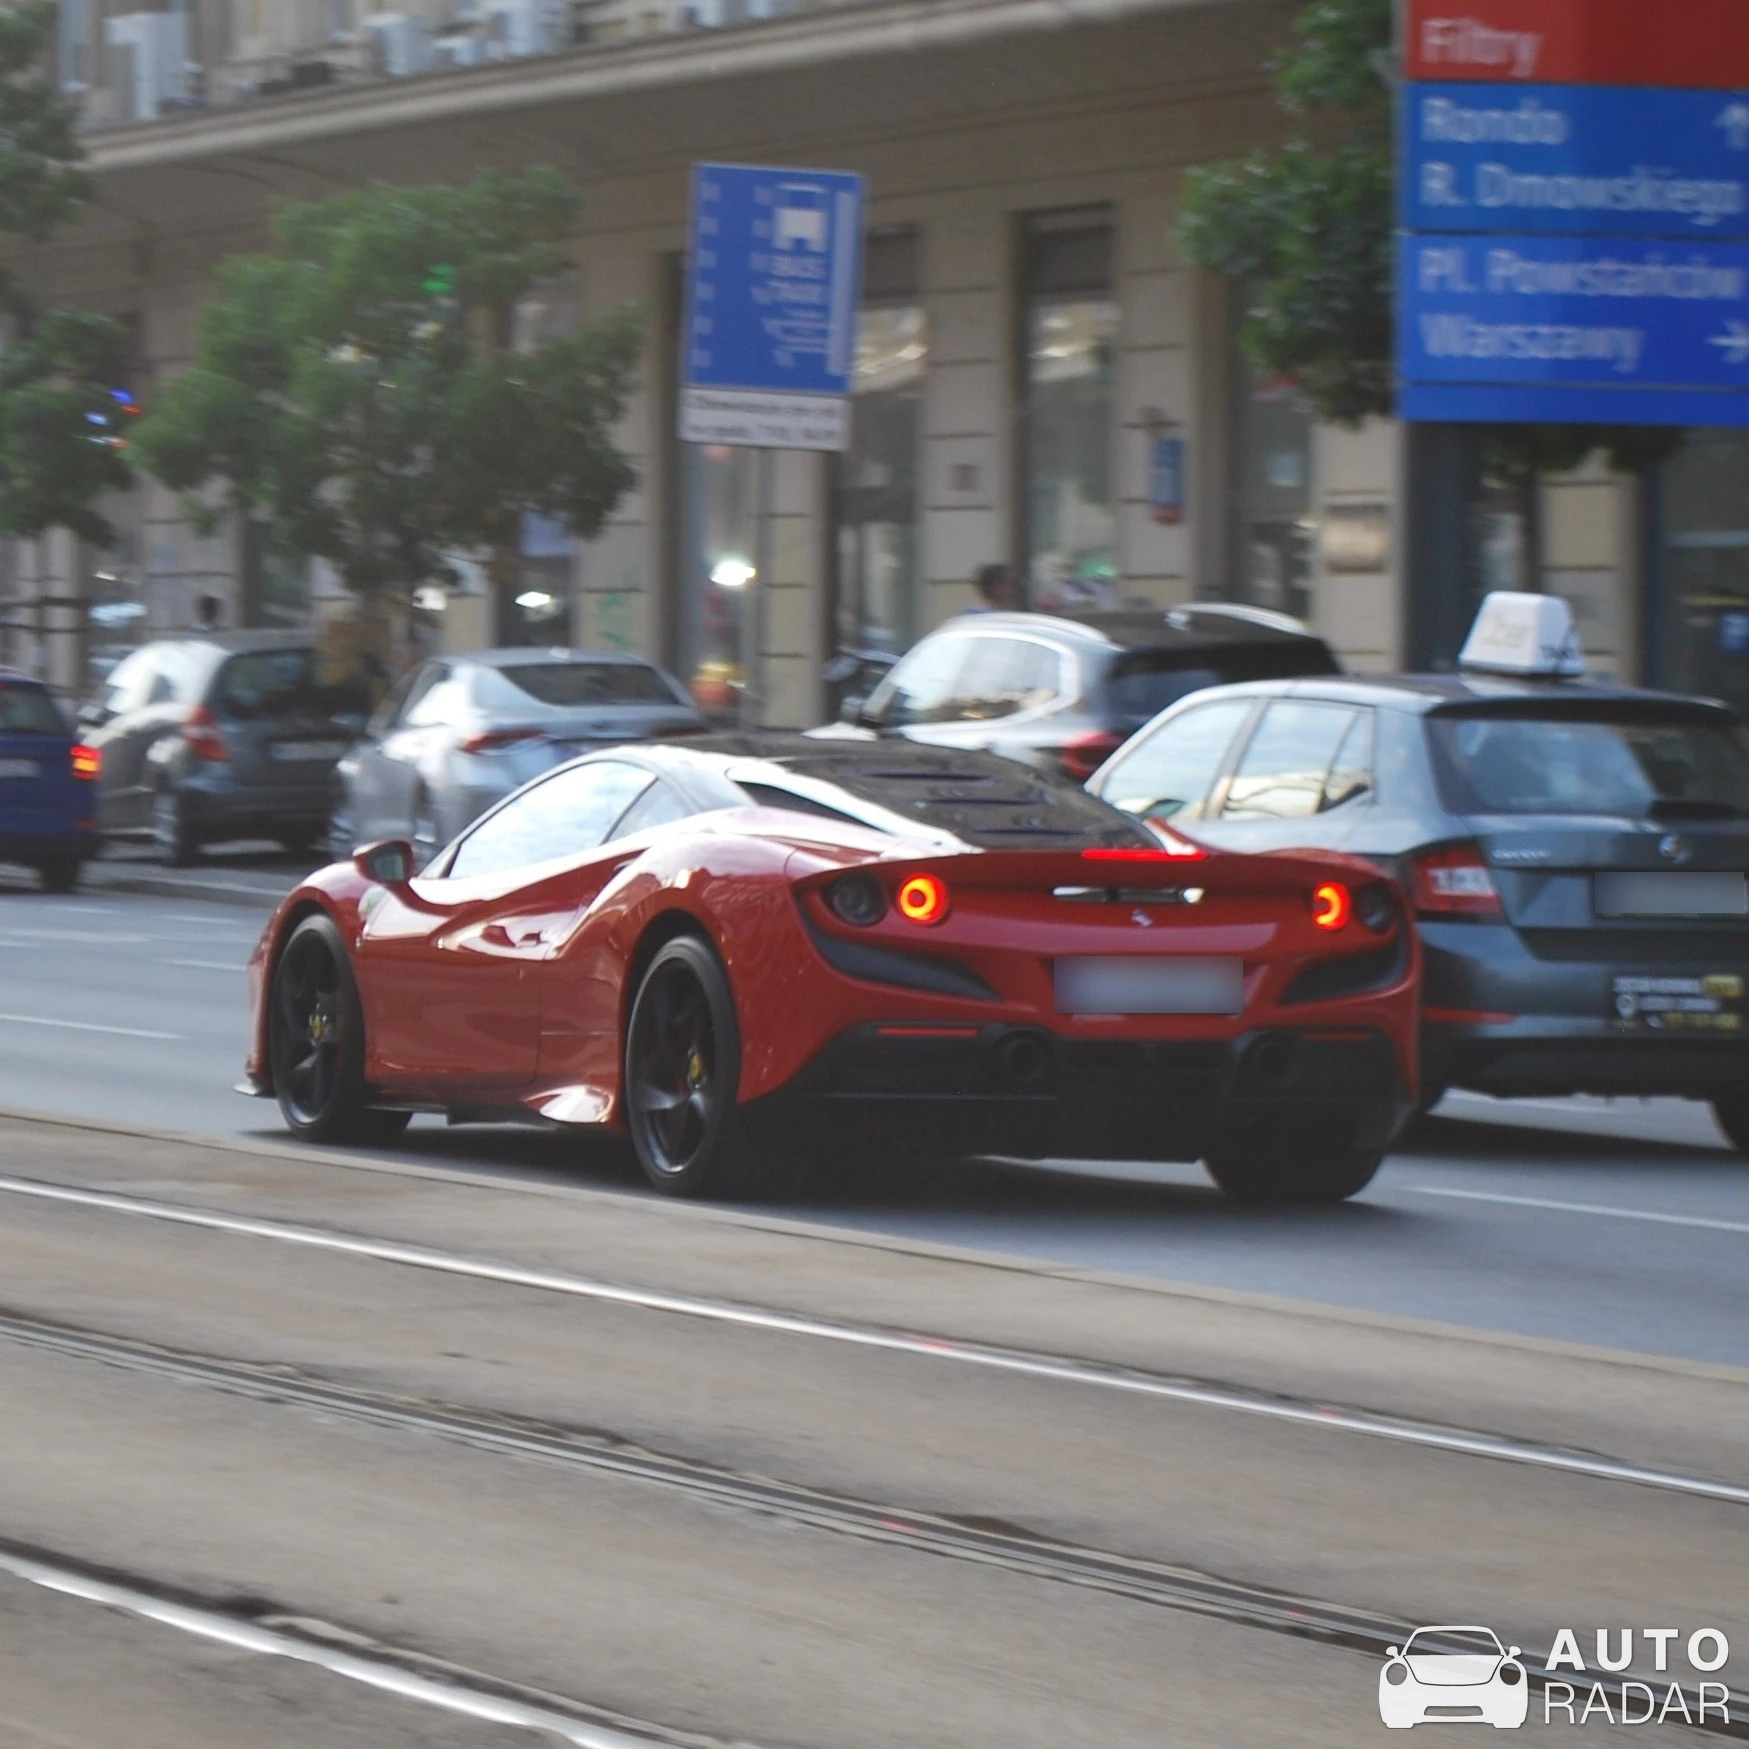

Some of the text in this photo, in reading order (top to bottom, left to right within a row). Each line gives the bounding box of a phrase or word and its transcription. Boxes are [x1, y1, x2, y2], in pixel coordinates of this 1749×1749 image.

[1421, 18, 1540, 77] Filtry
[1421, 98, 1566, 144] Rondo
[1477, 163, 1743, 226] Dmowskiego
[1420, 315, 1642, 373] Warszawy
